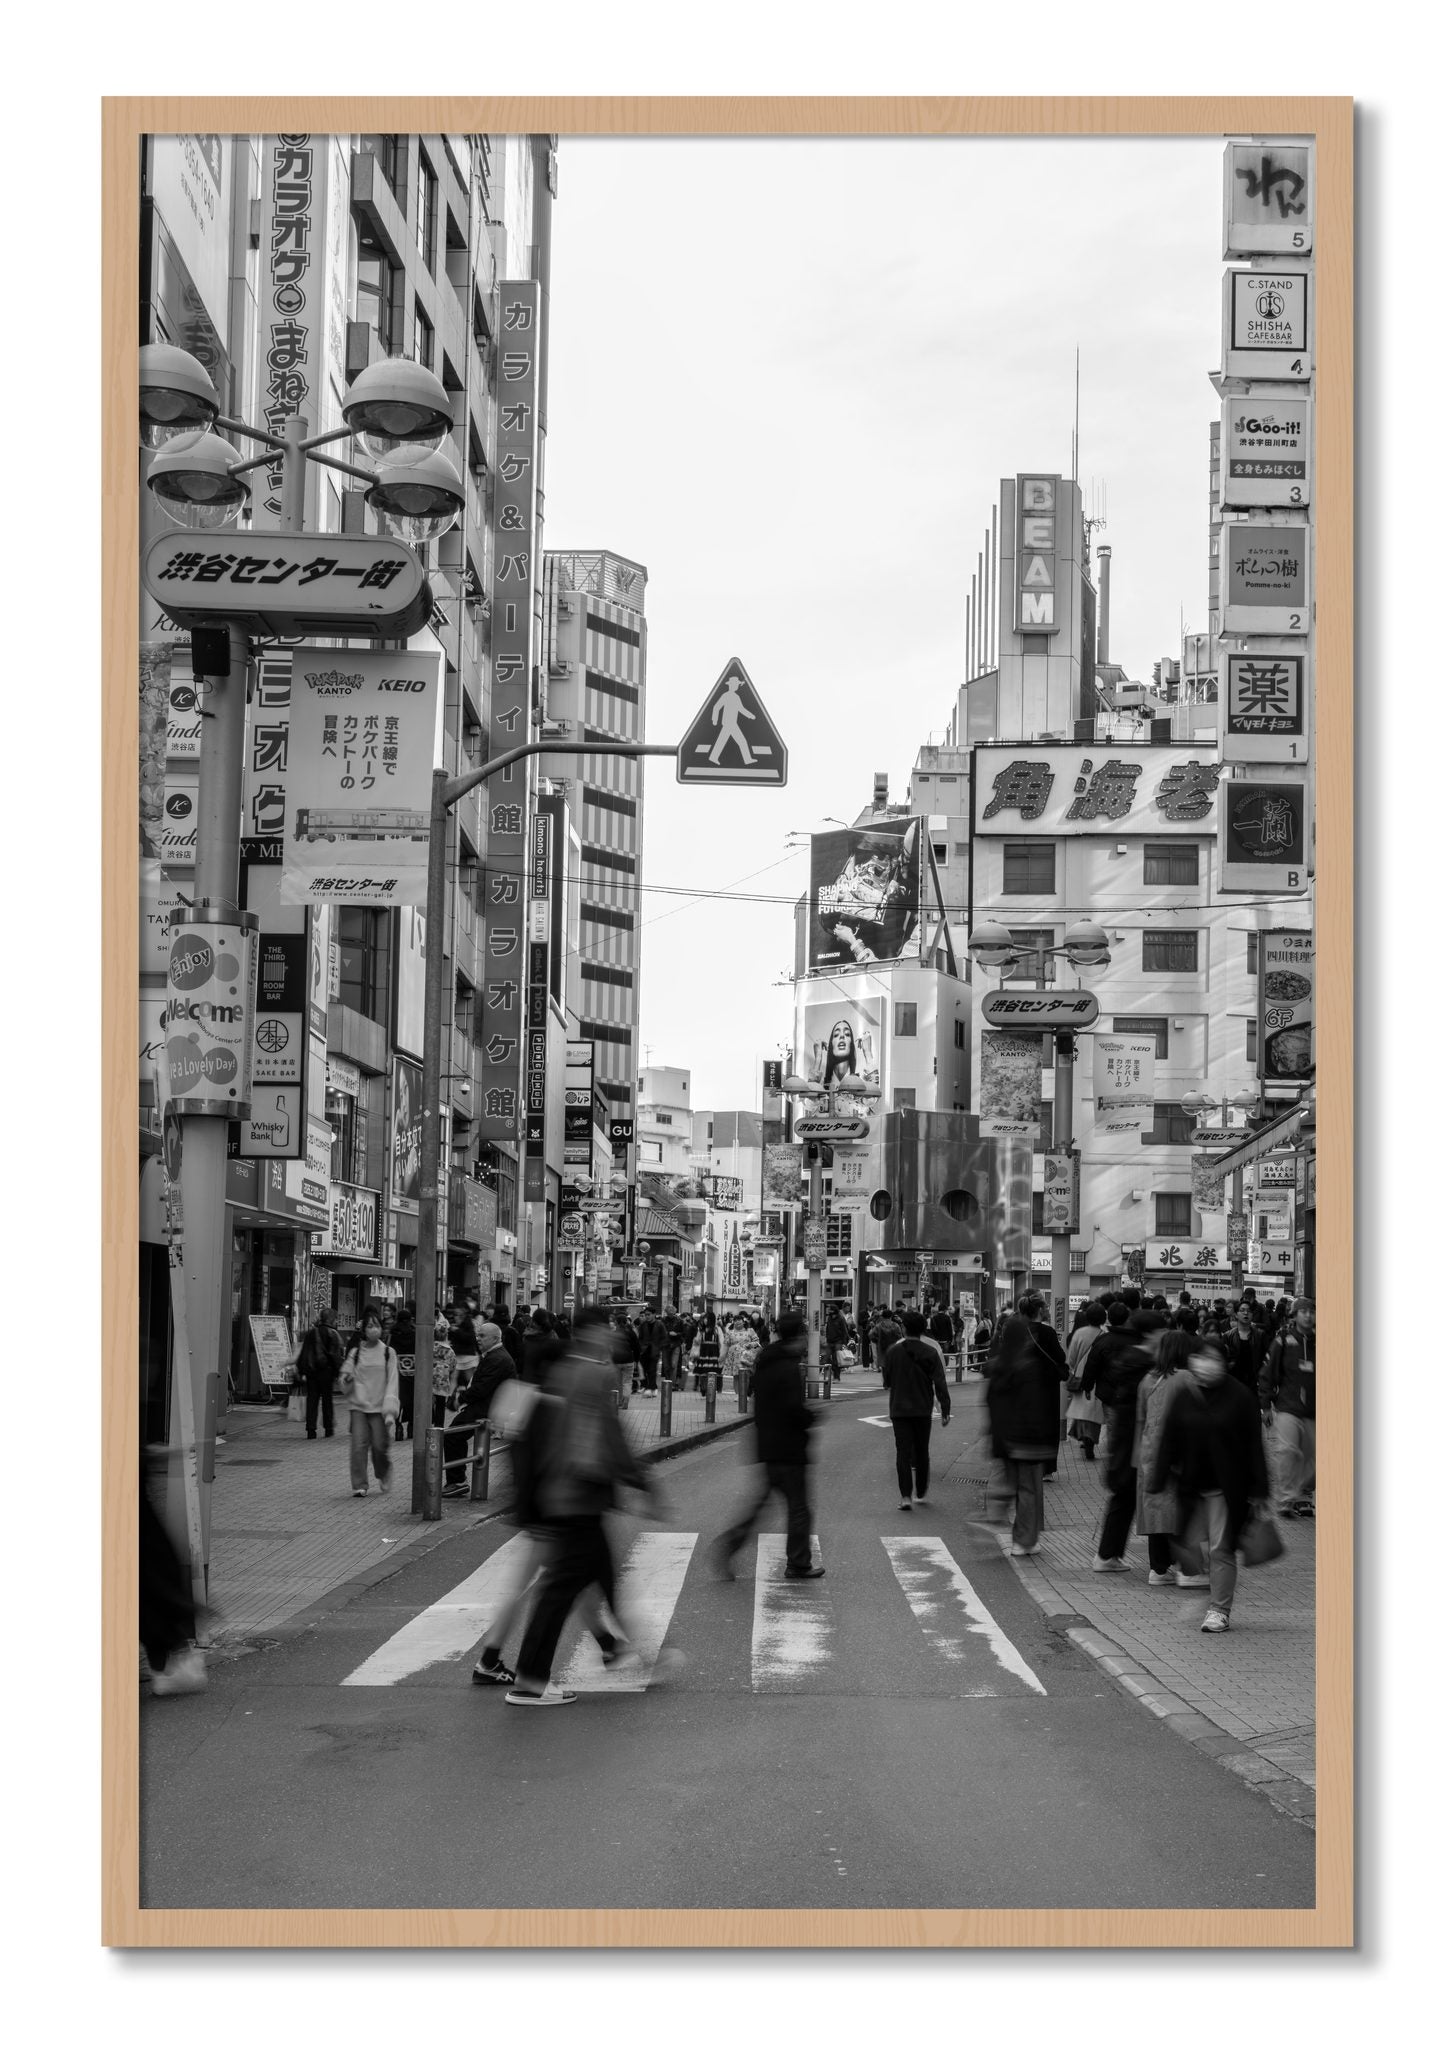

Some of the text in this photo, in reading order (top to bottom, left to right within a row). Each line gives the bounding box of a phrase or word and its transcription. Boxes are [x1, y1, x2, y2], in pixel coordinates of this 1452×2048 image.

[271, 147, 312, 286] カラオケ
[1293, 232, 1304, 248] 5
[1247, 280, 1293, 290] C.STAND
[1247, 320, 1292, 331] SHISHA
[1247, 332, 1292, 340] CAFE&BAR
[1291, 359, 1303, 374] 4
[1239, 438, 1298, 448] 渋谷宇田川町店
[1233, 463, 1302, 476] 全身もみほぐし
[1290, 486, 1302, 503] 3
[1022, 480, 1055, 625] BEAM
[157, 551, 408, 590] 渋谷センター街
[1289, 614, 1301, 630] 2
[317, 687, 352, 695] KANTO
[377, 679, 427, 693] KEIO
[1232, 717, 1295, 731] マツモトキヨシ
[321, 714, 338, 759] 冒険へ
[171, 743, 196, 751] 渋谷店
[340, 715, 359, 790] カントーの
[360, 715, 379, 790] ポケパーク
[382, 715, 400, 776] 京王線で
[1289, 742, 1297, 758] 1
[537, 819, 546, 855] kimono
[167, 850, 192, 859] 渋谷店
[309, 878, 398, 891] 渋谷センター街
[1288, 871, 1299, 887] B
[170, 948, 212, 983] Enjoy
[166, 998, 244, 1024] Welcome
[989, 1000, 1092, 1013] 渋谷センター街
[1264, 1008, 1295, 1029] 6F
[183, 1055, 214, 1077] Lovely
[216, 1057, 236, 1072] Day!
[251, 1122, 284, 1133] Whisky
[612, 1125, 632, 1137] GU
[250, 1132, 271, 1140] Bank
[730, 1244, 740, 1286] BEER
